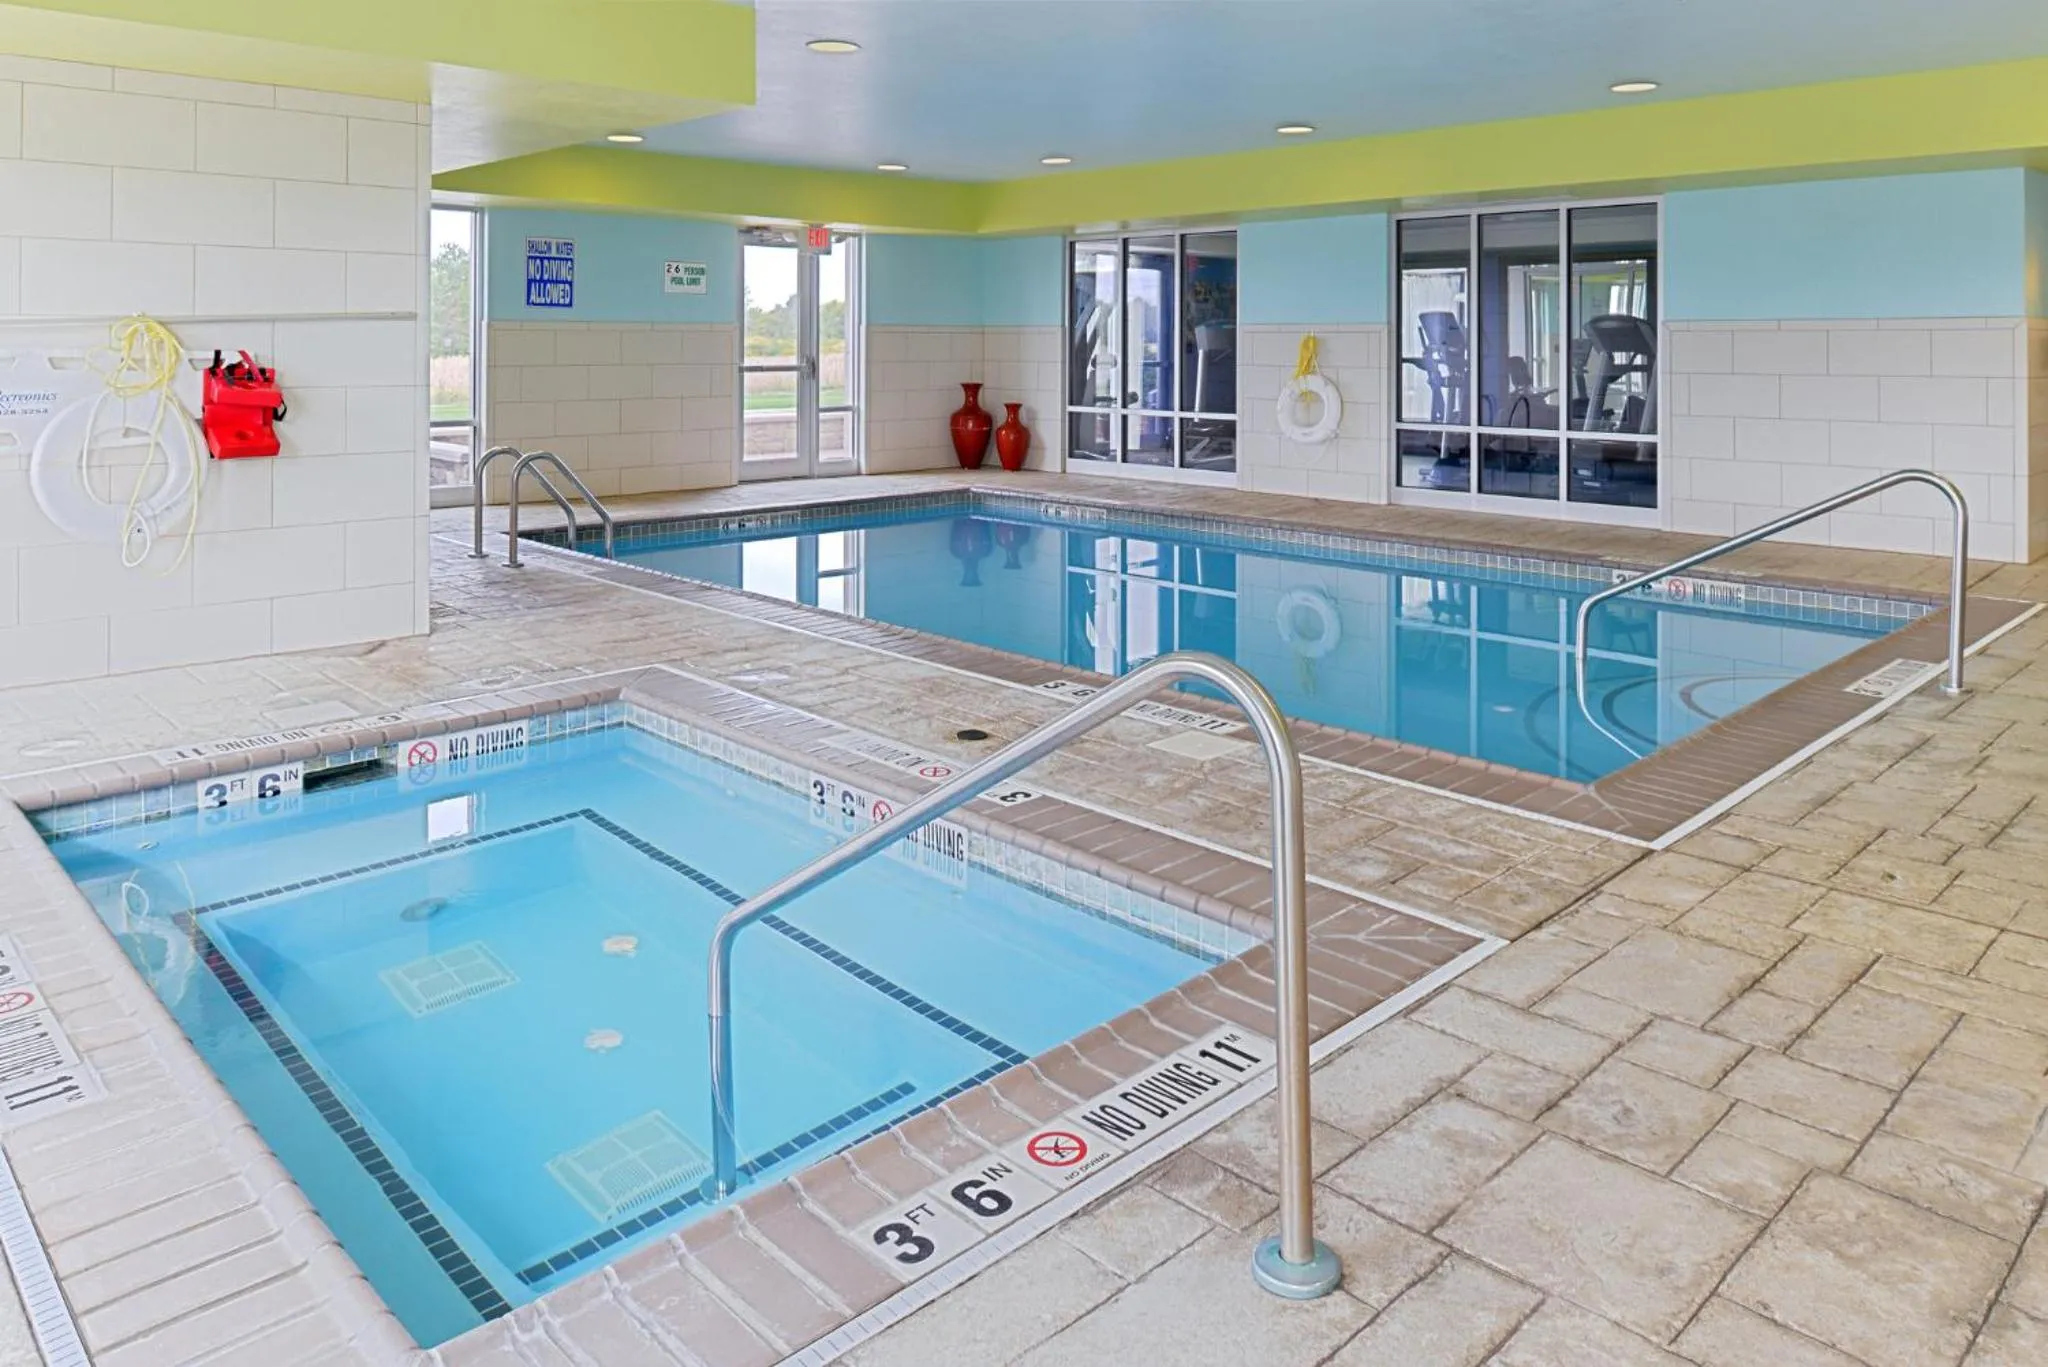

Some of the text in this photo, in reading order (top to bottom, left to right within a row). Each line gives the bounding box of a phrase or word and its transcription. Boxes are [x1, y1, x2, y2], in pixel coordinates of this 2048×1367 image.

[528, 240, 573, 256] SHALLOW WATER
[808, 228, 828, 248] EXIT
[528, 258, 573, 282] NO DIVING
[529, 282, 571, 305] ALLOWED
[215, 734, 279, 752] DIVING
[448, 726, 525, 761] NO DIVING
[205, 767, 299, 809] 3 FT 6 IN
[923, 821, 964, 862] DIVING
[1081, 1104, 1147, 1142] NO
[1118, 1062, 1222, 1119] DIVING
[1198, 1040, 1262, 1074] 1.1
[1064, 1151, 1111, 1182] NO DIVING
[873, 1162, 1014, 1265] 3 FT 6 IN
